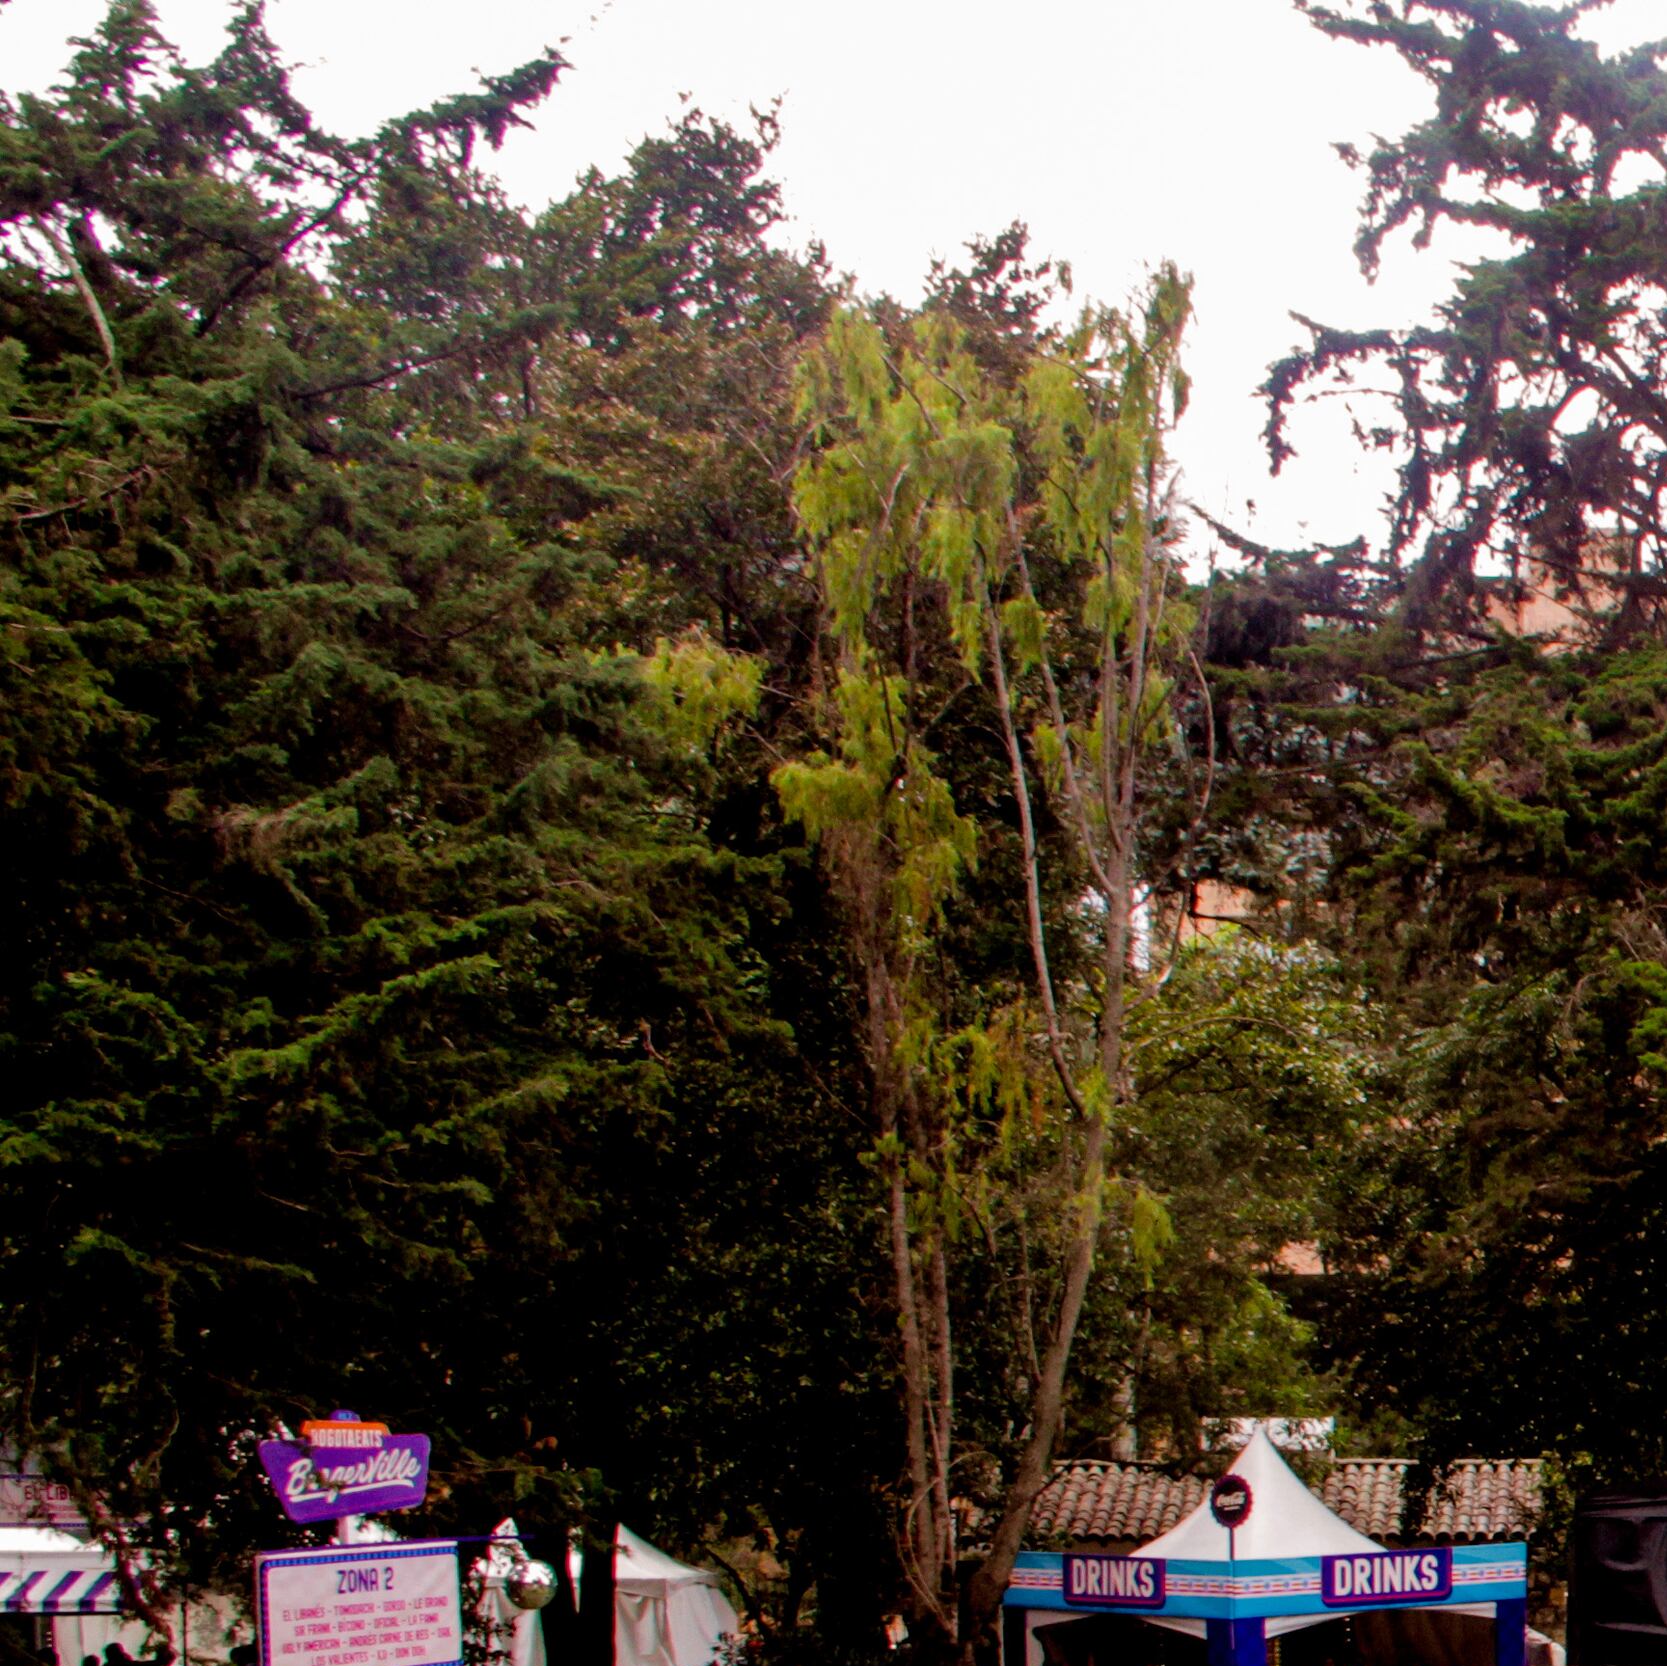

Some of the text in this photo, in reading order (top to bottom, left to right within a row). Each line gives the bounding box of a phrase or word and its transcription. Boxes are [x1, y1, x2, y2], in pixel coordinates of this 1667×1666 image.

[337, 1566, 394, 1594] ZONA 2
[1072, 1558, 1155, 1598] DRINKS
[1334, 1554, 1439, 1597] DRINKS
